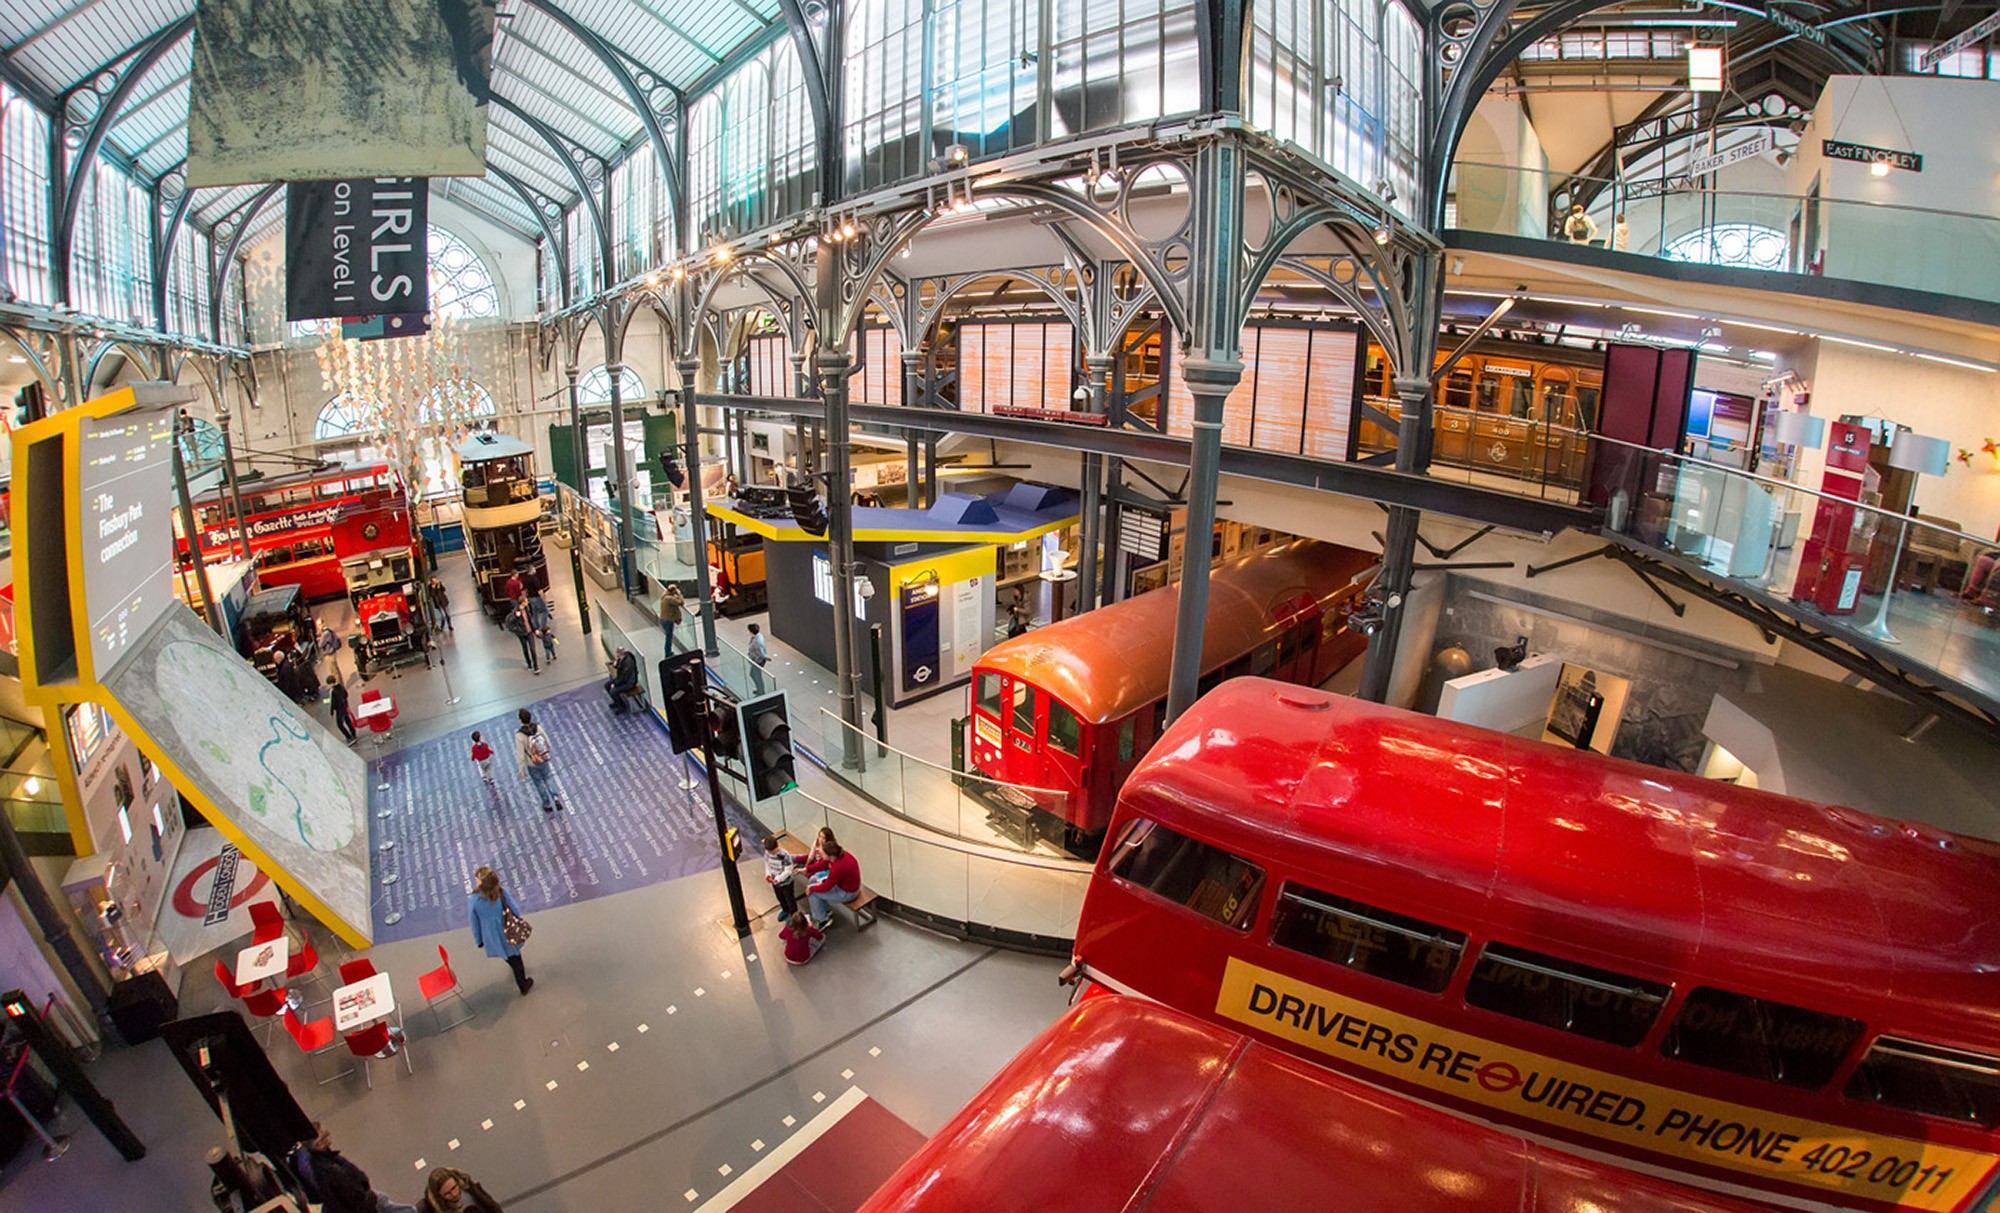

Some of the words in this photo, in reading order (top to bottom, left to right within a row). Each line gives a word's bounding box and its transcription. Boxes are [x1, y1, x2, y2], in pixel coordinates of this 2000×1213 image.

[1772, 9, 1825, 45] PLAISTOW
[1694, 156, 1724, 173] BAKER
[1730, 138, 1767, 161] STREET
[1827, 144, 1853, 157] EAST
[1854, 147, 1918, 168] FINCHLEY
[334, 182, 351, 215] on
[370, 178, 413, 301] IRLS
[333, 225, 355, 290] level
[1451, 420, 1458, 428] 3
[99, 494, 114, 513] The
[253, 515, 293, 534] Gazette
[101, 530, 138, 563] connection
[1247, 983, 1419, 1064] DRIVERS
[1654, 1108, 1799, 1165] PHONE
[1800, 1143, 1871, 1182] 402
[1868, 1159, 1954, 1196] 0011
